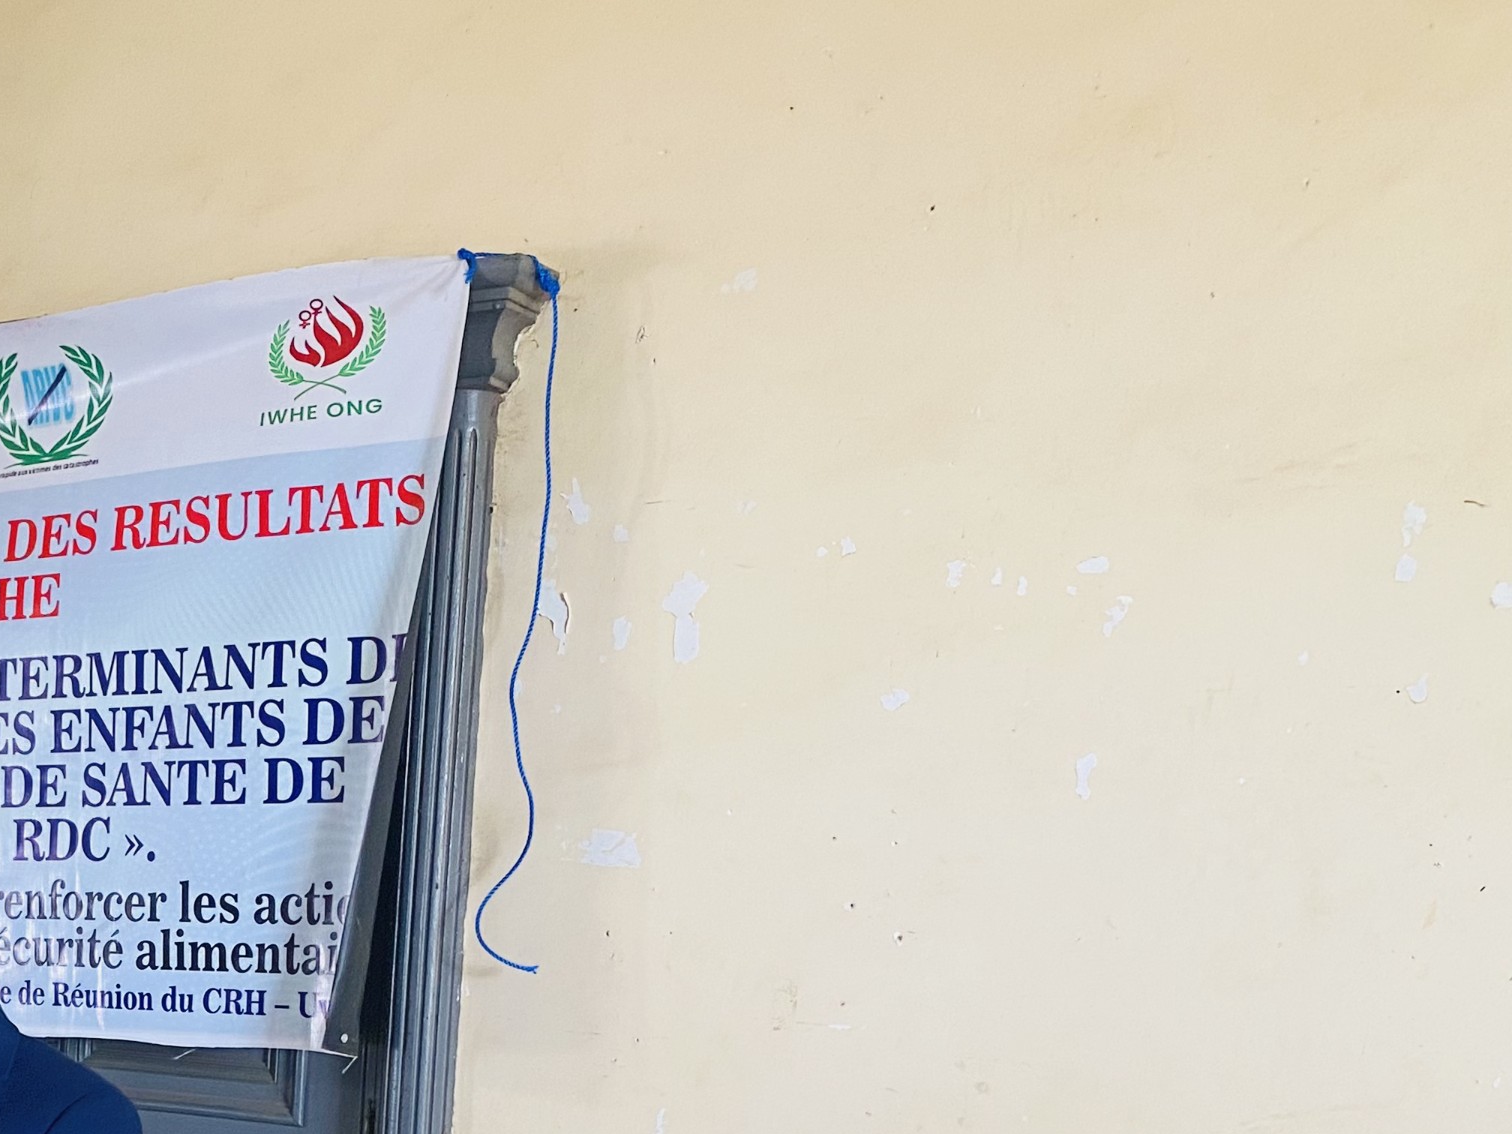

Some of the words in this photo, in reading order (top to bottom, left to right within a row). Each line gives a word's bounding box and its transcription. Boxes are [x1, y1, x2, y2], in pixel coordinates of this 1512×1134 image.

[259, 404, 318, 427] IWHE
[326, 398, 383, 418] ONG
[4, 508, 98, 563] DES
[110, 473, 426, 552] RESULTATS
[51, 698, 285, 754] ENFANTS
[302, 695, 385, 747] DE
[1, 764, 67, 808] DE
[81, 760, 247, 808] SANTE
[263, 756, 345, 805] DE
[12, 816, 111, 863] RDC
[179, 880, 240, 926] les
[18, 980, 45, 1006] de
[52, 982, 154, 1013] Réunion
[160, 984, 194, 1014] du
[203, 988, 266, 1016] CRH
